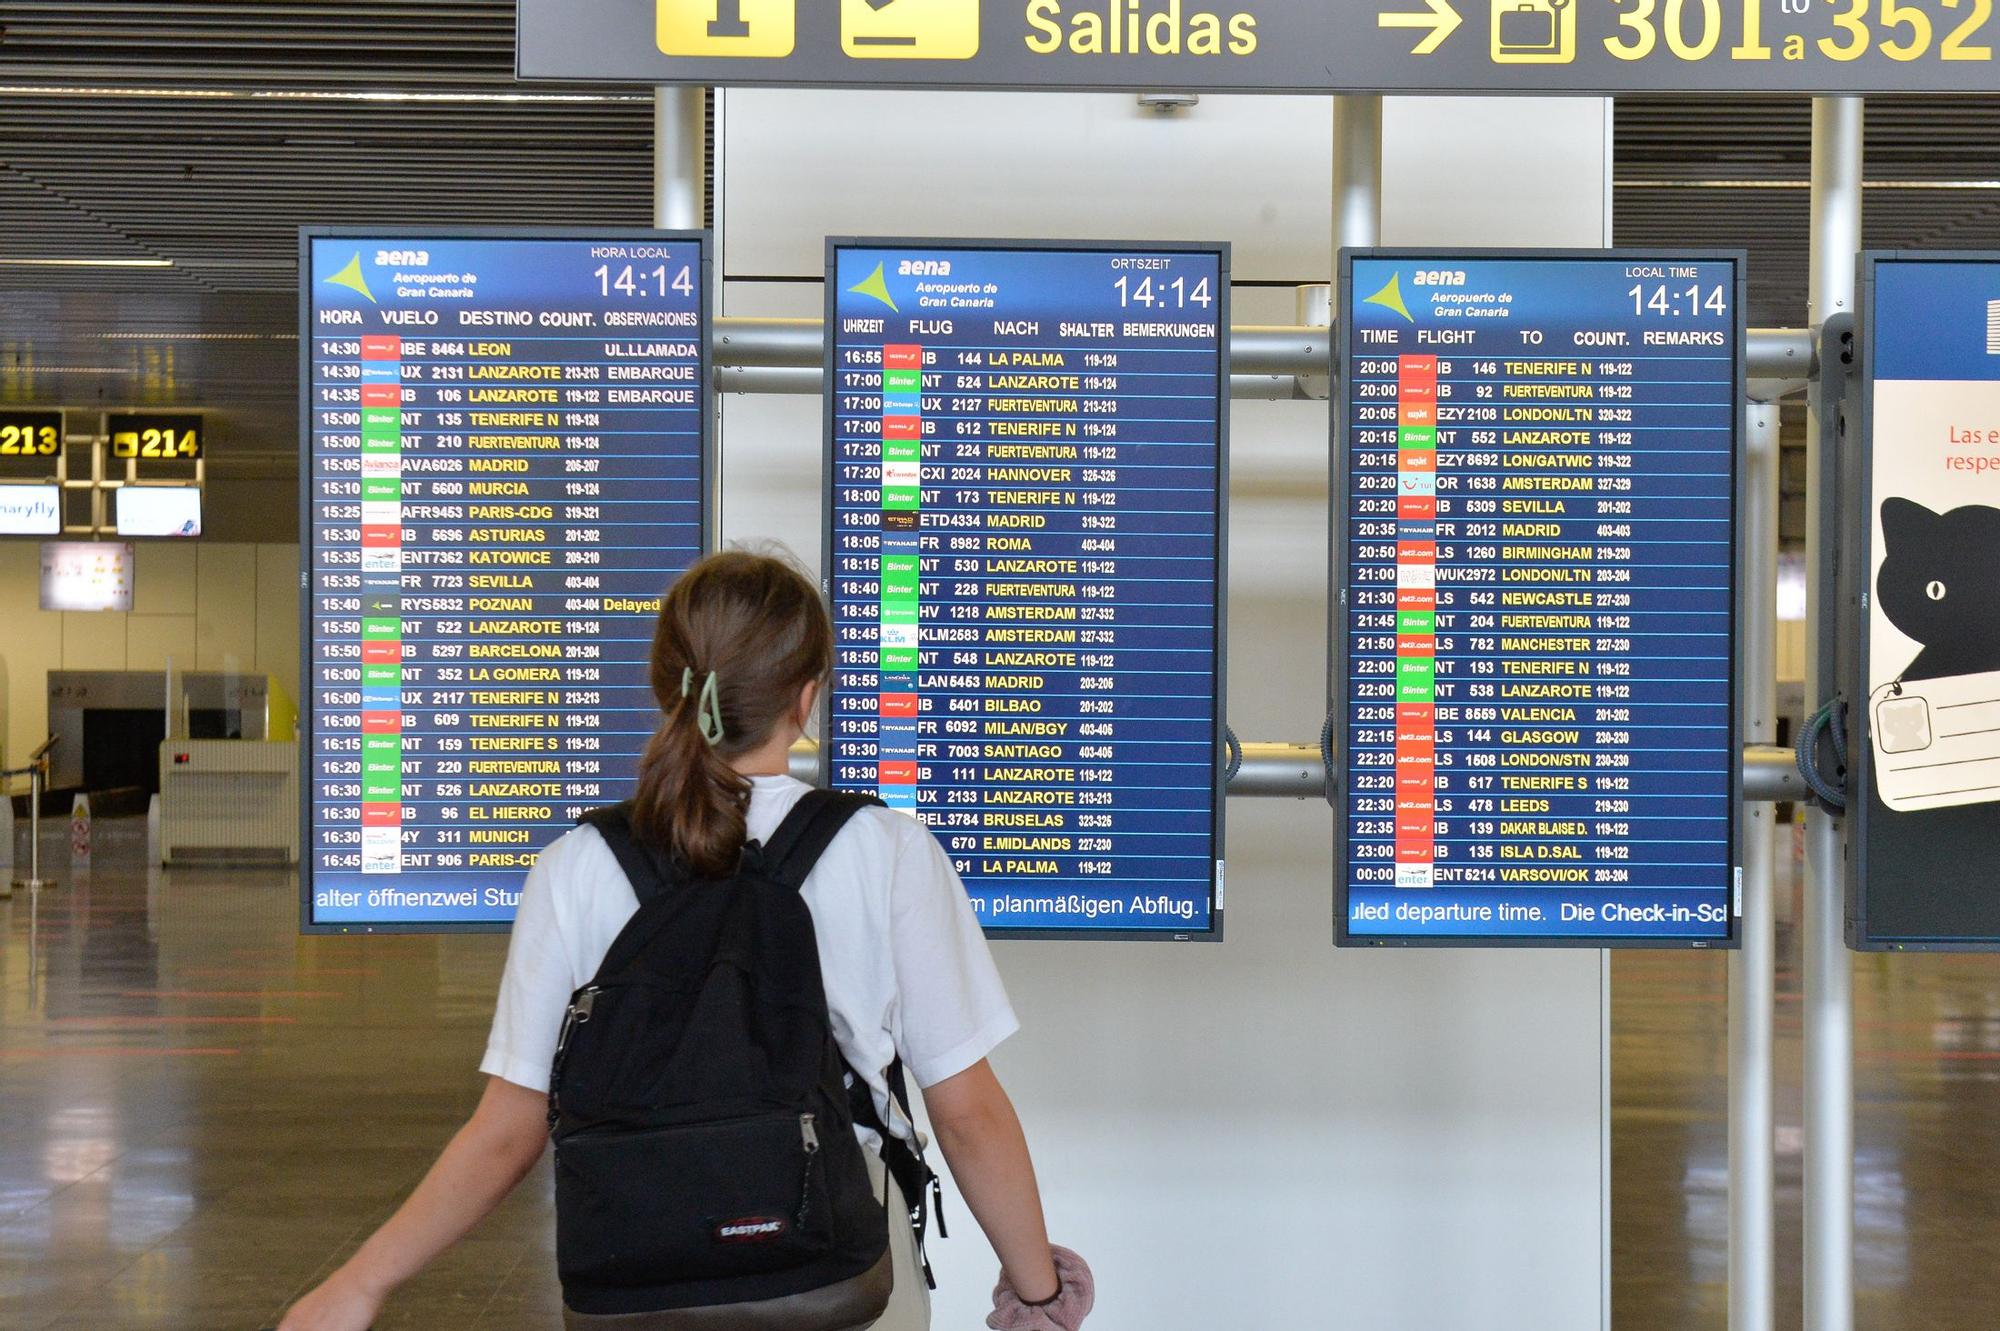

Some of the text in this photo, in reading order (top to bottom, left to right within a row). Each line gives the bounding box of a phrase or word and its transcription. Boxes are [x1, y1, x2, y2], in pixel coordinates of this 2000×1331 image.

[1025, 0, 1257, 55] Salidas
[1603, 0, 1771, 60] 301
[1783, 35, 1804, 60] a
[1817, 0, 1992, 61] 352
[375, 250, 429, 266] aena
[591, 247, 670, 258] HORA LOCAL
[898, 260, 951, 276] aena
[1111, 258, 1171, 269] ORTSZEIT
[393, 272, 477, 285] Aeropuerto de
[1413, 271, 1466, 285] aena
[1626, 267, 1697, 278] LOCAL TIME
[594, 265, 693, 296] 14:14
[915, 282, 998, 294] Aeropuerto de
[397, 287, 473, 298] Gran Canaria
[1114, 276, 1211, 308] 14:14
[1430, 293, 1512, 304] Aeropuerto de
[919, 296, 994, 307] Gran Canaria
[1629, 284, 1726, 316] 14:14
[320, 310, 697, 327] HORA VUELO DESTINO COUNT. OBSERVACIONES
[1434, 306, 1509, 317] Gran Canaria
[844, 319, 1215, 337] UHRZEIT FLUG NACH SHALTER BEMERKUNGEN
[1360, 330, 1724, 346] TIME FLIGHT TO COUNT. REMARKS
[321, 342, 361, 355] 14:30
[401, 342, 426, 355] IBE
[468, 343, 511, 356] LEON
[605, 344, 698, 357] UL.LLAMADA
[845, 351, 882, 363] 16:55
[922, 352, 936, 364] IB
[958, 352, 982, 365] 144
[989, 353, 1008, 366] LA
[1013, 353, 1064, 366] PALMA
[321, 365, 360, 378] 14:30
[401, 366, 422, 378] UX
[469, 366, 561, 379] LANZAROTE
[608, 367, 694, 379] EMBARQUE
[844, 373, 881, 386] 17:00
[888, 376, 916, 386] Binter
[922, 375, 942, 387] NT
[957, 376, 981, 389] 524
[989, 376, 1079, 389] LANZAROTE
[321, 389, 361, 401] 14:35
[401, 389, 416, 402] IB
[469, 389, 558, 402] LANZAROTE
[608, 390, 694, 403] EMBARQUE
[844, 420, 881, 433] 17:00
[921, 422, 936, 434] IB
[956, 422, 981, 434] 612
[988, 422, 1061, 436] TENERIFE
[1066, 422, 1076, 436] N
[1949, 426, 1982, 444] Las
[0, 426, 57, 454] 213
[141, 428, 197, 458] 214
[1359, 431, 1396, 443] 20:15
[1404, 432, 1431, 441] Binter
[1437, 431, 1457, 444] NT
[1472, 431, 1496, 444] 552
[1503, 432, 1590, 444] LANZAROTE
[1946, 455, 2000, 474] respe
[322, 482, 360, 494] 15:10
[401, 482, 422, 495] NT
[469, 482, 529, 495] MURCIA
[842, 536, 880, 548] 18:05
[920, 537, 939, 549] FR
[950, 537, 980, 549] 8982
[987, 537, 1032, 550] ROMA
[1359, 546, 1396, 558] 20:50
[1436, 546, 1454, 559] LS
[1466, 546, 1496, 559] 1260
[1502, 547, 1592, 559] BIRMINGHAM
[469, 598, 532, 611] POZNAN
[604, 598, 662, 613] Delayed
[1358, 661, 1395, 673] 22:00
[1402, 664, 1429, 672] Binter
[1435, 661, 1455, 673] NT
[1470, 661, 1494, 674] 193
[1501, 661, 1575, 674] TENERIFE
[1579, 661, 1589, 674] N
[322, 738, 361, 750] 16:15
[402, 738, 422, 750] NT
[469, 738, 544, 750] TENERIFE
[548, 738, 558, 750] S
[840, 743, 877, 756] 19:30
[919, 744, 937, 757] FR
[948, 745, 979, 758] 7003
[984, 745, 1062, 758] SANTIAGO
[1357, 799, 1394, 811] 22:30
[1434, 799, 1452, 811] LS
[1468, 799, 1493, 812] 478
[1501, 799, 1549, 812] LEEDS
[316, 889, 362, 907] alter
[367, 888, 477, 907] öffnenzwei
[993, 895, 1123, 918] planmäßigen
[1129, 896, 1198, 919] Abflug.
[1395, 902, 1492, 922] departure
[1498, 903, 1546, 921] time.
[1561, 903, 1595, 921] Die
[720, 1221, 779, 1237] EASTPAK
